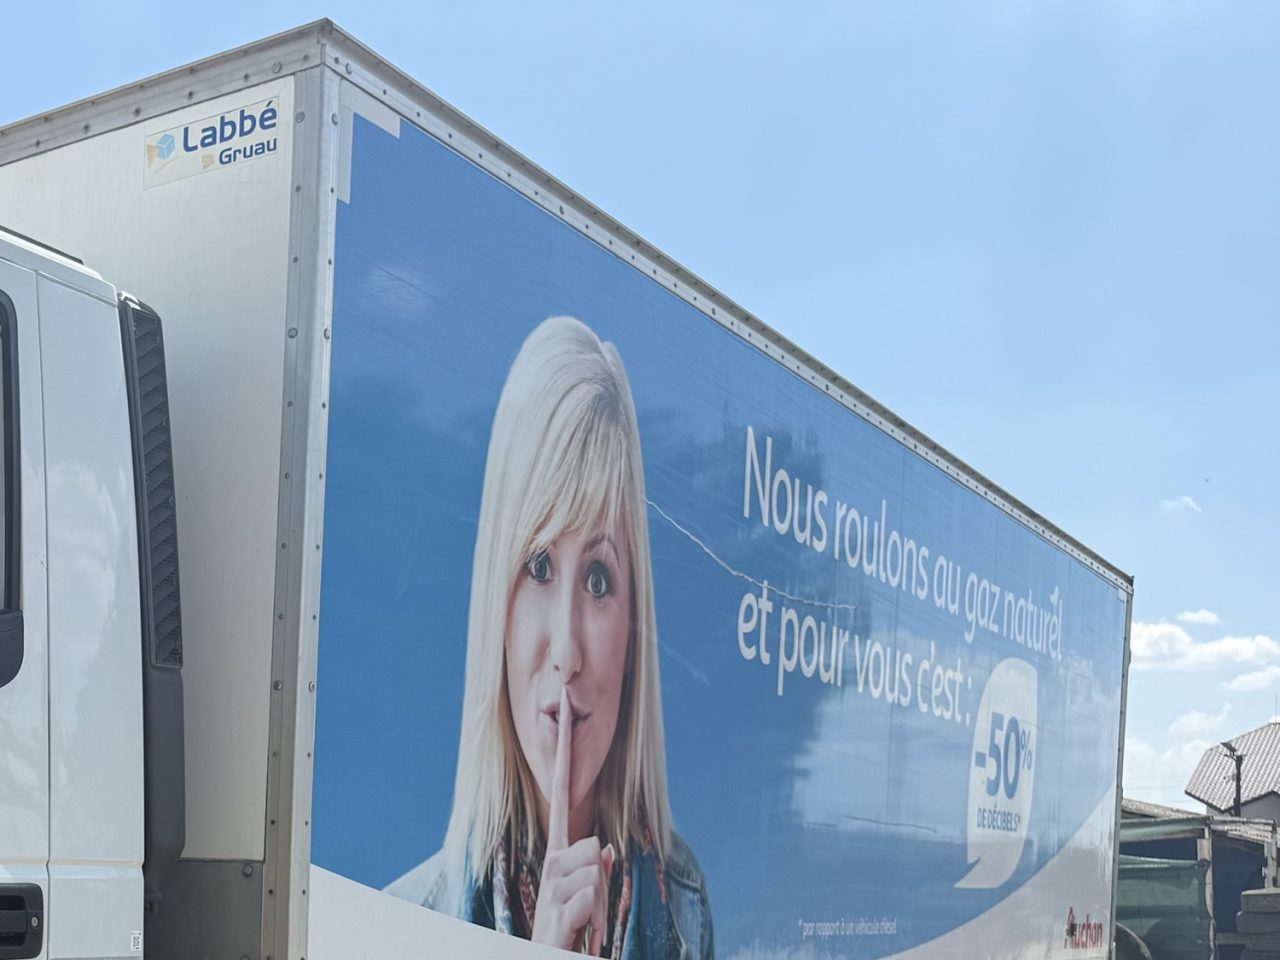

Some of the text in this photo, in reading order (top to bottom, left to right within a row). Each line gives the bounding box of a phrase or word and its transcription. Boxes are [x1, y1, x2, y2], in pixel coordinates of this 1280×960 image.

[182, 99, 278, 153] Labbé
[218, 138, 278, 166] Gruau
[743, 425, 1064, 662] Nous roulons au gaz naturel
[737, 579, 774, 665] et
[777, 605, 850, 697] pour
[854, 634, 913, 709] vous
[976, 807, 987, 828] DE
